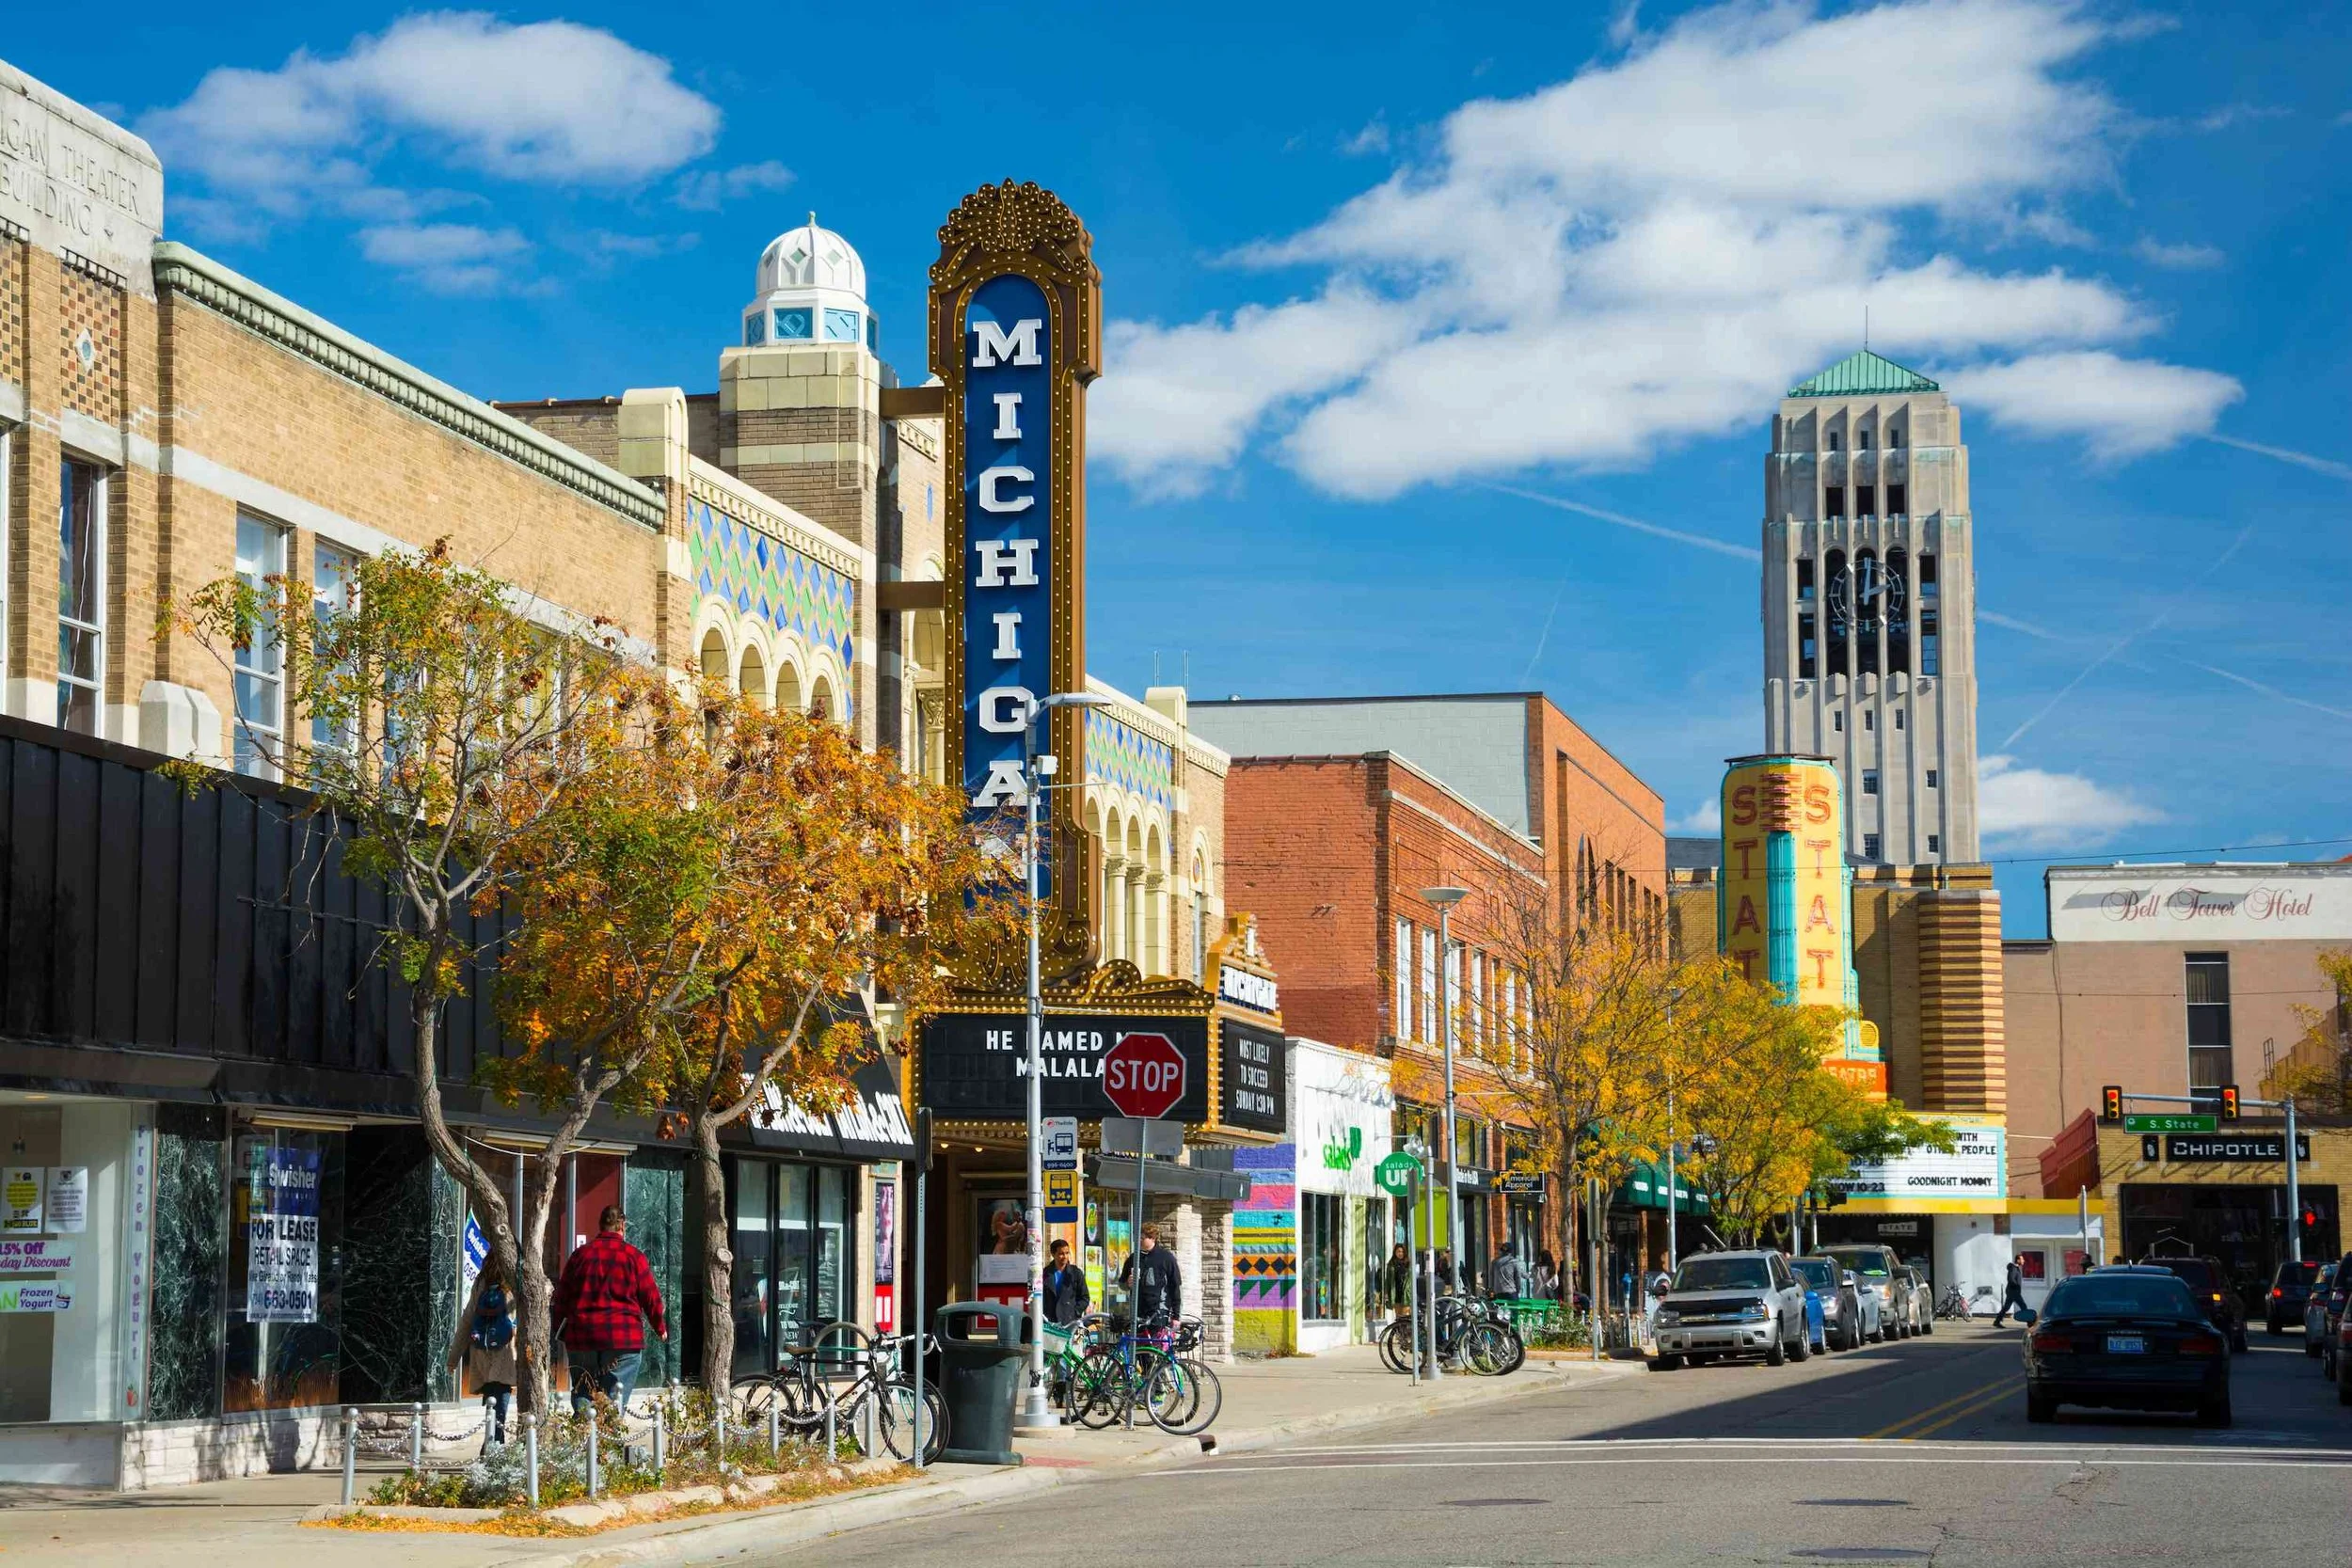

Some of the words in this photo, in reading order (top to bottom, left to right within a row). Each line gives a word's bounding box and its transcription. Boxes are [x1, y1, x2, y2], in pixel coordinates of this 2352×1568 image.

[62, 145, 139, 216] THEATER
[0, 162, 91, 236] BUILDING
[1731, 786, 1762, 979] STAT
[1804, 786, 1836, 1010] STAT
[2101, 887, 2161, 921] Bell
[2167, 887, 2237, 921] Tower
[2243, 886, 2312, 922] Hotel
[986, 1031, 1013, 1051] HE
[1026, 1031, 1103, 1051] AMED
[1239, 1038, 1252, 1060] MOST
[1253, 1042, 1270, 1064] LIKELY
[1110, 1059, 1179, 1092] STOP
[1240, 1065, 1248, 1084] TO
[1248, 1069, 1268, 1088] SUCCEED
[1236, 1089, 1255, 1111] SUNDAY
[2150, 1119, 2161, 1129] S.
[2165, 1119, 2200, 1129] State
[1926, 1145, 1953, 1154] OTHE
[1962, 1146, 1996, 1155] PEOPLE
[2173, 1142, 2280, 1155] CHIPOTLE
[134, 1124, 147, 1232] Frozen
[269, 1163, 316, 1189] Swisher
[1908, 1176, 1957, 1186] GOODNIGHT
[1960, 1177, 1993, 1186] MOMMY
[251, 1219, 275, 1240] FOR
[279, 1220, 316, 1242] LEASE
[0, 1242, 21, 1256] 15%
[24, 1242, 45, 1255] Off
[254, 1246, 283, 1265] RETAIL
[286, 1247, 310, 1266] SPACE
[24, 1255, 72, 1268] Discount
[20, 1288, 54, 1297] Frozen
[264, 1290, 312, 1309] 663-0501
[20, 1299, 53, 1309] Yogurt
[131, 1252, 143, 1361] Yogurt
